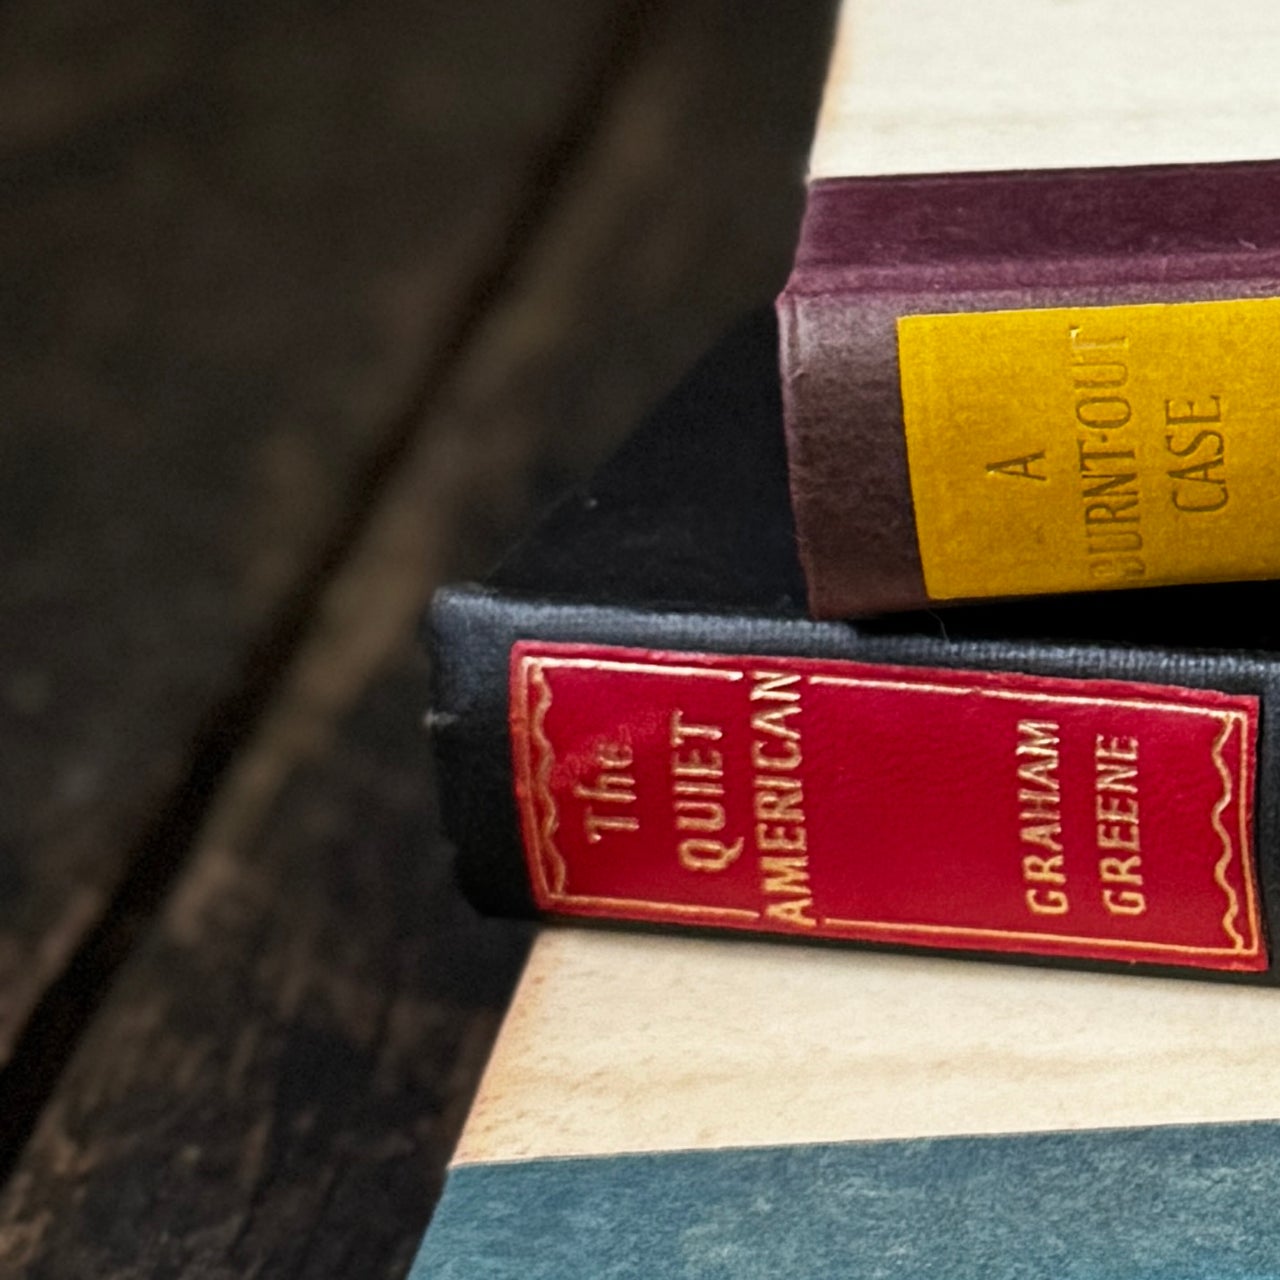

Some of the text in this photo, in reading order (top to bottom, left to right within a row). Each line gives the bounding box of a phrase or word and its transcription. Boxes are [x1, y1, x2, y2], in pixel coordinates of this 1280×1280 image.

[986, 450, 1047, 482] A
[1165, 394, 1229, 514] CASE
[574, 739, 640, 843] The
[671, 709, 745, 873] QUIET
[749, 670, 817, 926] AMERICAN
[1015, 720, 1070, 916] GRAHAM
[1095, 733, 1147, 916] GREENE
